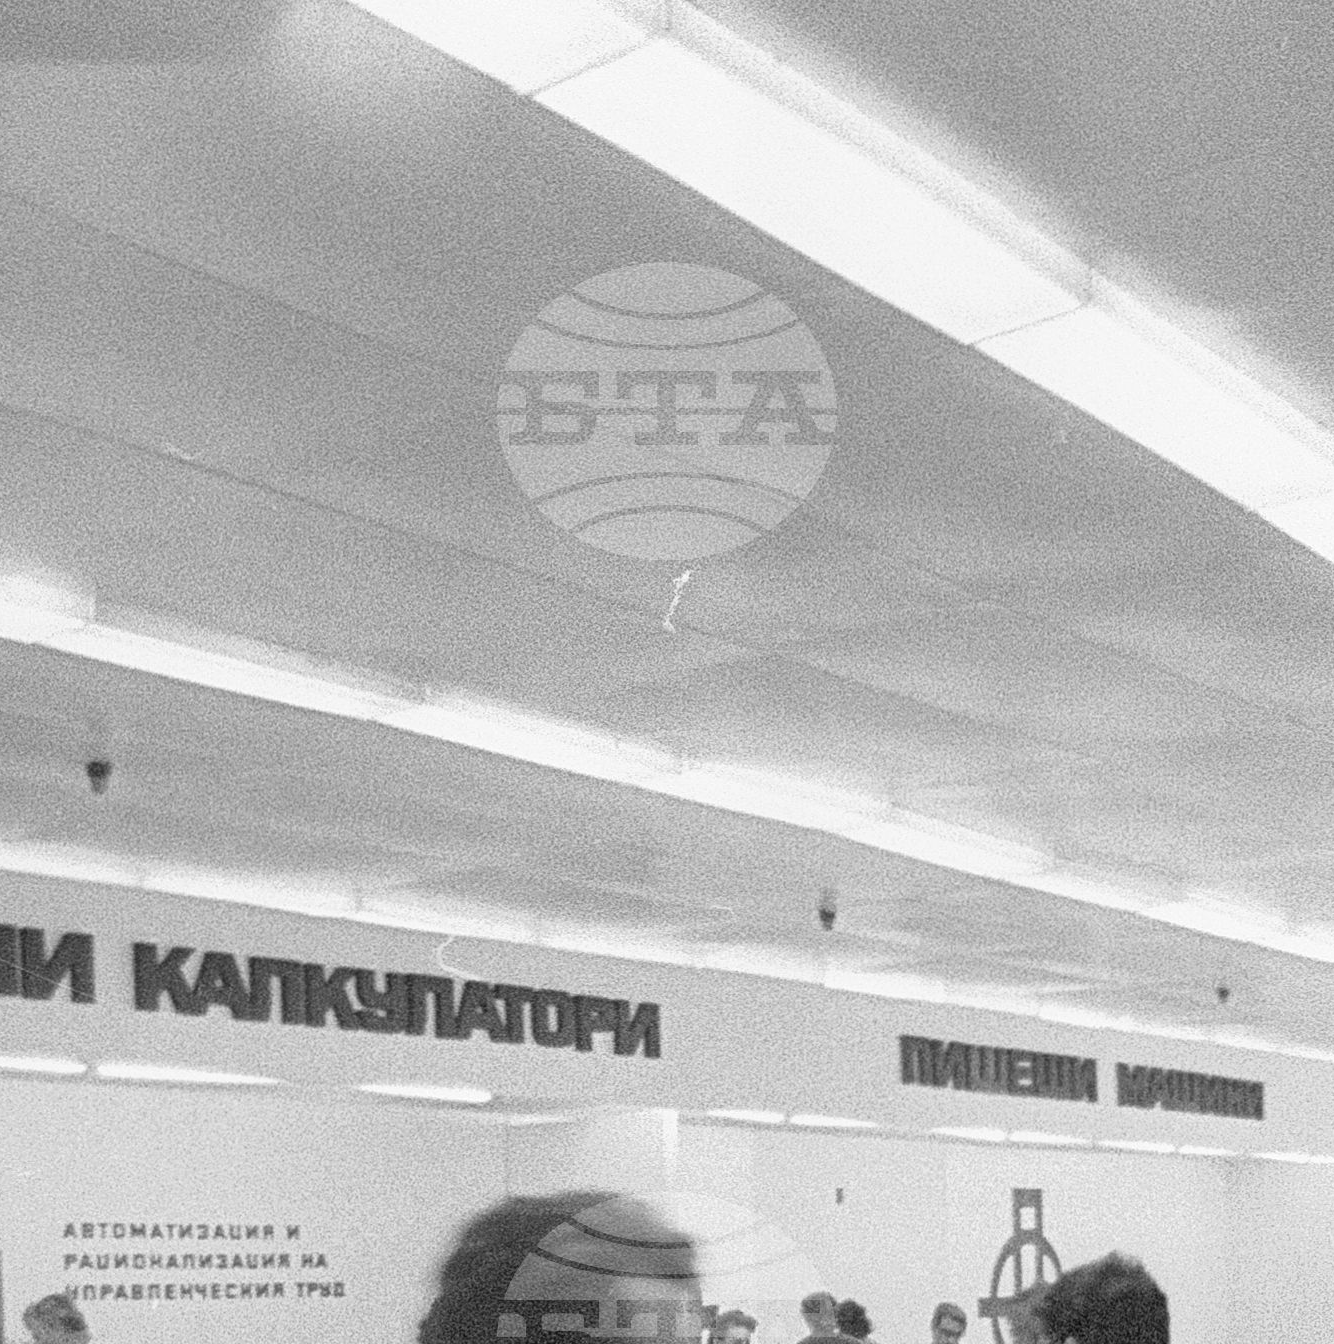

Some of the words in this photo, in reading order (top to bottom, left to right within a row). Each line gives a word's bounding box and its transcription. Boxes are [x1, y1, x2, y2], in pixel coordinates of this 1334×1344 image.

[131, 942, 661, 1059] КАЛКУЛАТОРИ
[63, 1223, 275, 1241] АВТОМАТИЗАЦИЯ
[286, 1224, 301, 1240] И
[63, 1252, 291, 1269] РАЦИОНАЛИЗАЦИЯ
[301, 1253, 329, 1268] НА
[295, 1281, 347, 1298] ТРУД
